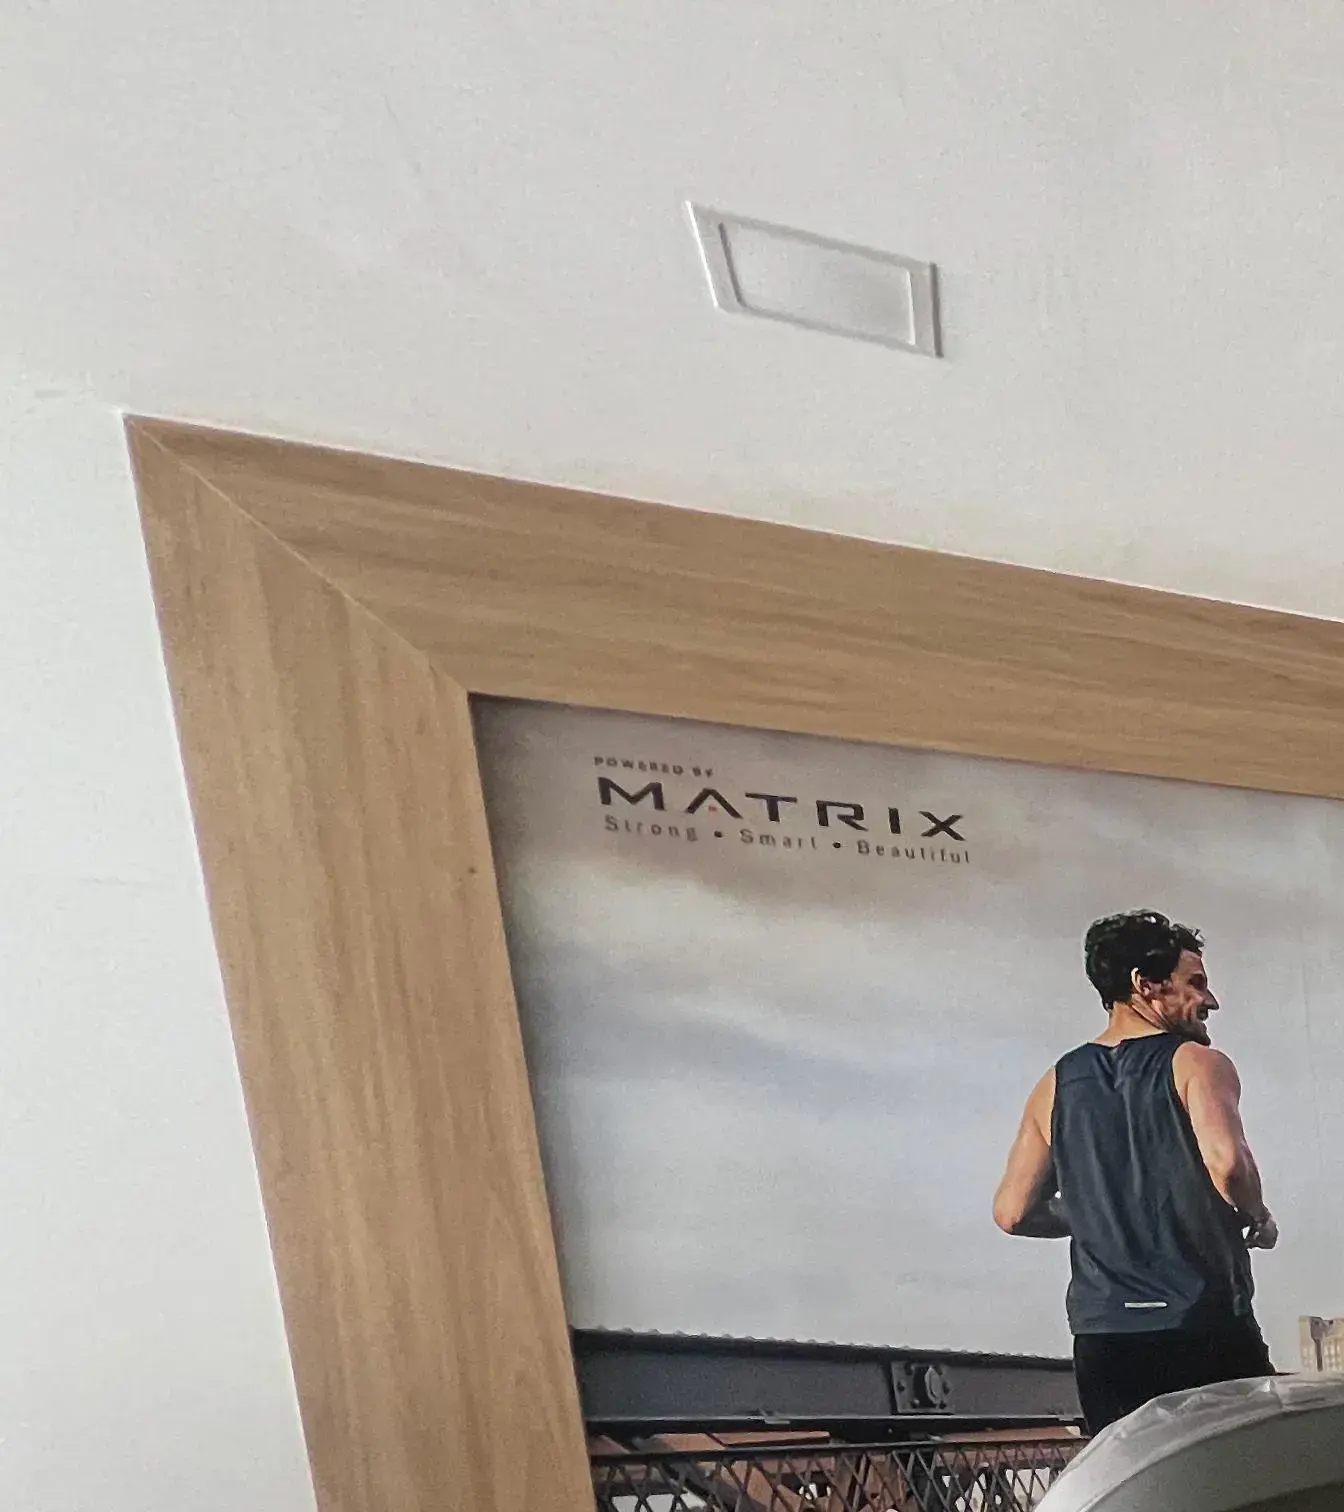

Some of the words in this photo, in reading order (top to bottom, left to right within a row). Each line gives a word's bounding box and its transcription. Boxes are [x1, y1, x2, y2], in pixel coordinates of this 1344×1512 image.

[593, 756, 684, 776] POWERED
[692, 766, 714, 778] BY
[597, 776, 966, 842] MATRIX
[604, 814, 698, 842] Strong
[739, 828, 816, 850] Smart
[857, 839, 970, 864] Beautiful
